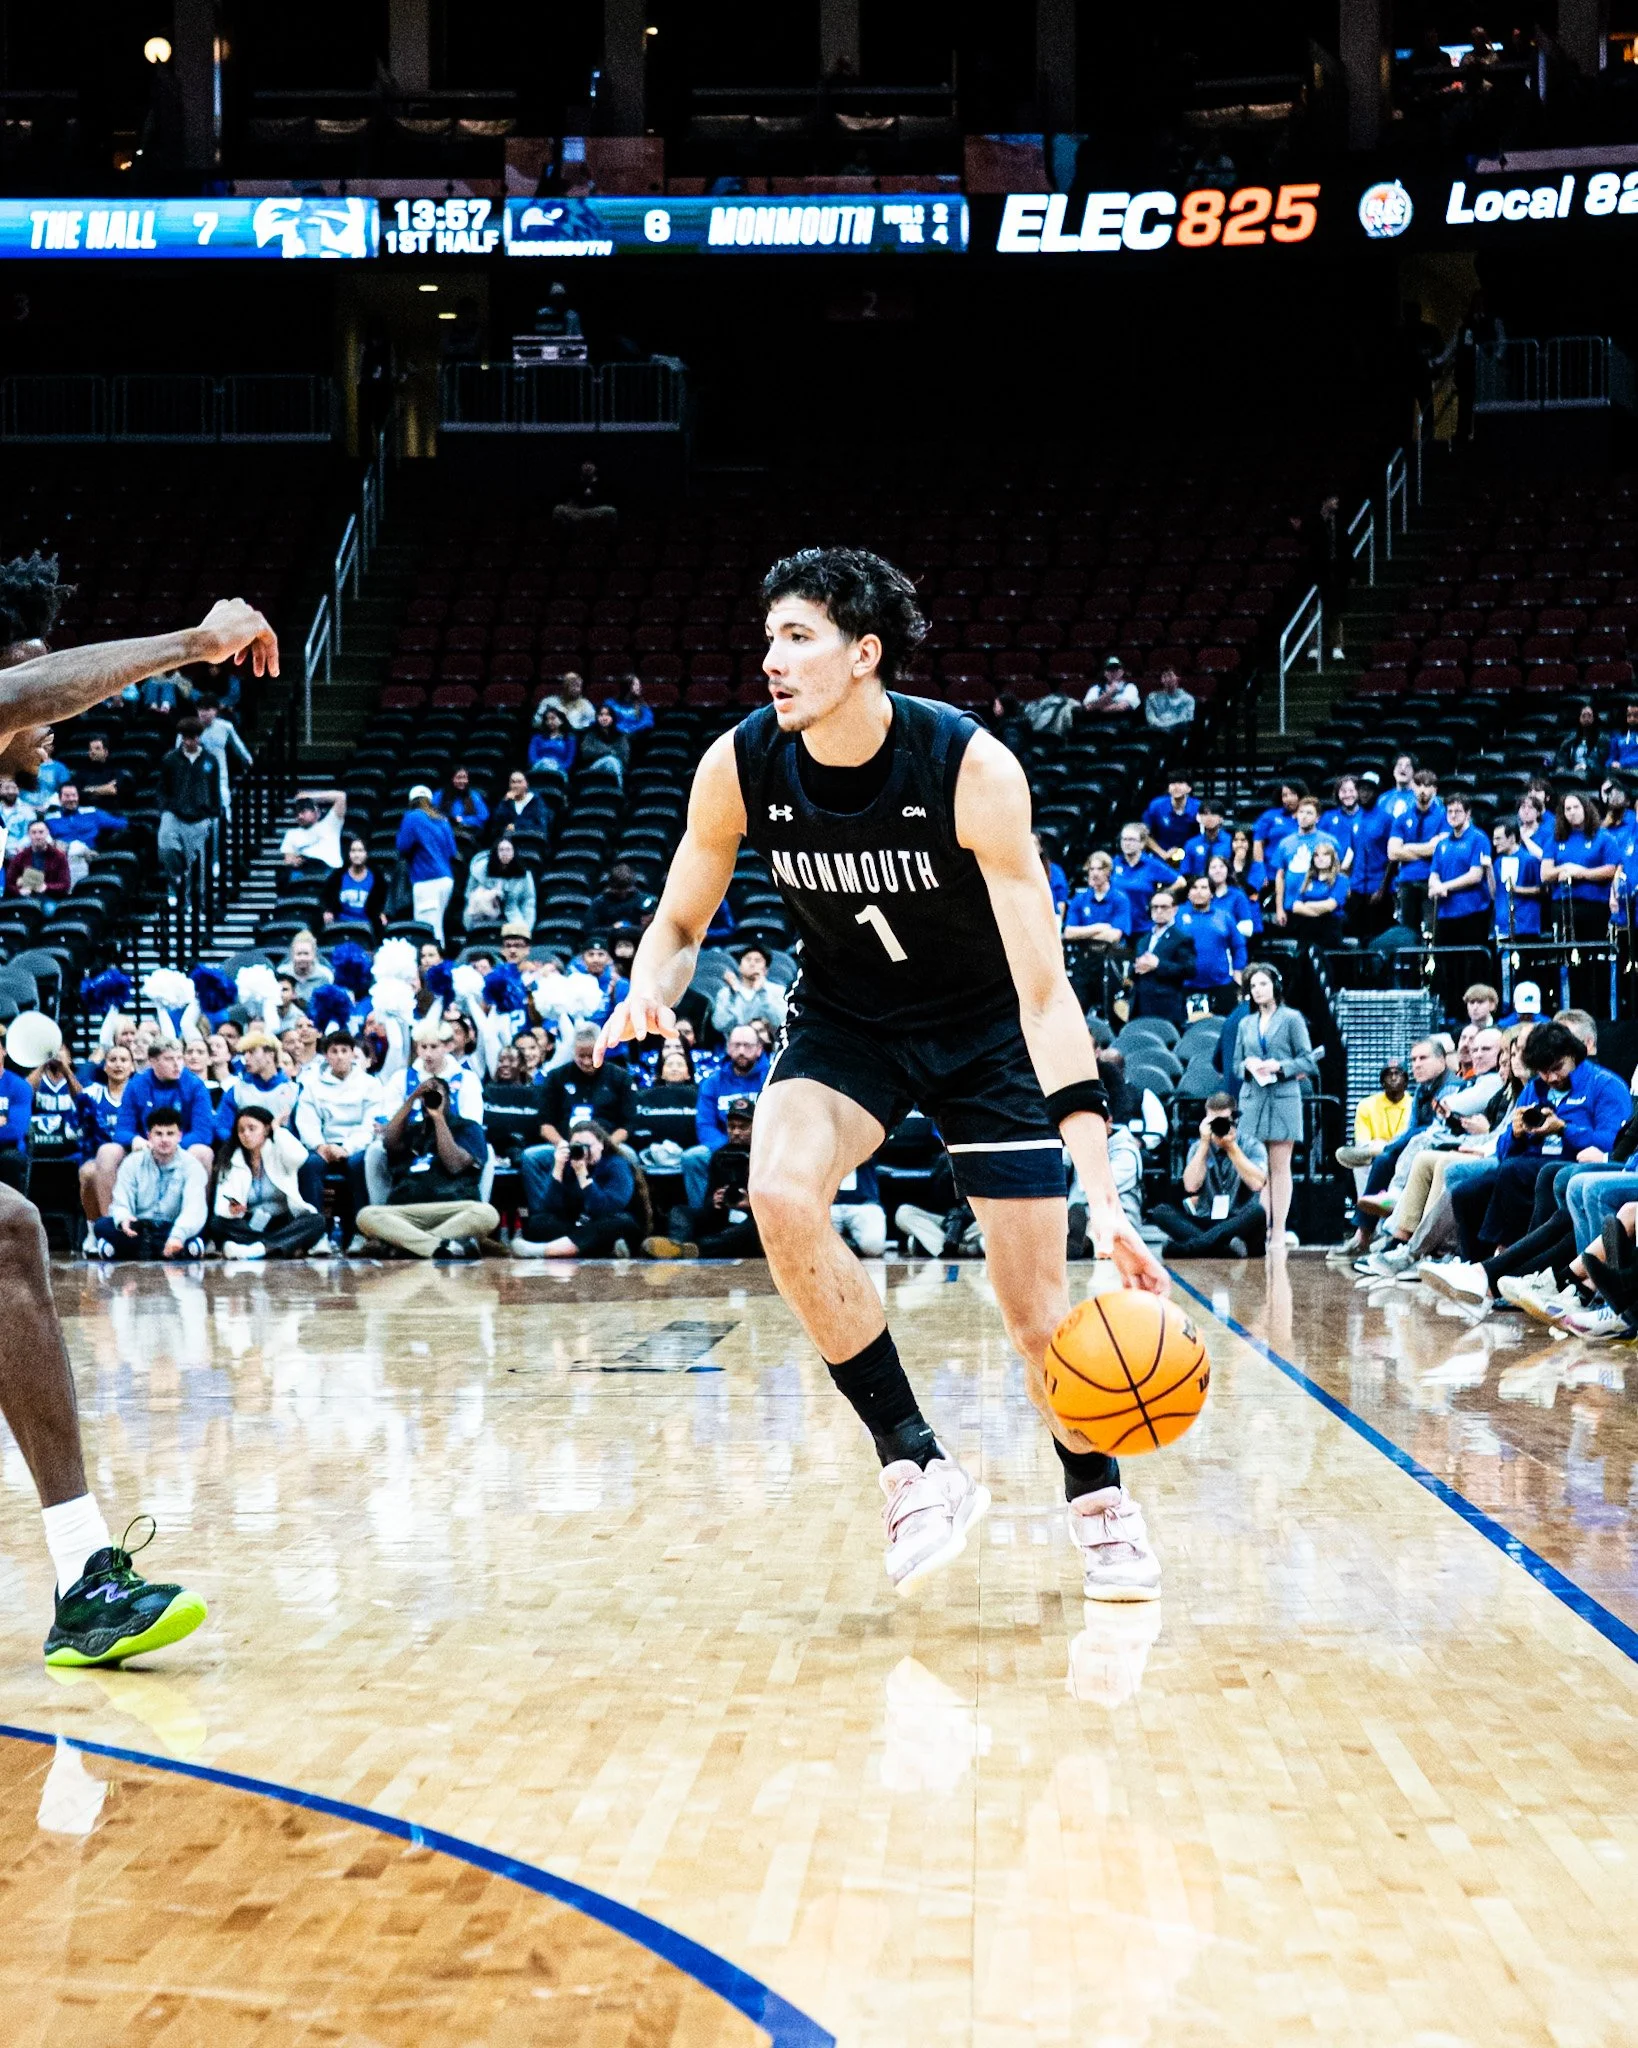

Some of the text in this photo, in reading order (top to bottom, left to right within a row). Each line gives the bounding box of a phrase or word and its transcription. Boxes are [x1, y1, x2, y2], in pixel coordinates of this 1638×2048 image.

[394, 199, 492, 231] 13:57
[1445, 175, 1576, 225] Local
[29, 210, 157, 250] THE HALL
[193, 211, 219, 246] 7
[385, 229, 500, 254] 1ST HALF
[644, 209, 671, 243] 6
[708, 206, 876, 246] MONMOUTH
[932, 224, 949, 245] 4
[771, 849, 940, 894] MONMOUTH
[854, 904, 908, 962] 1
